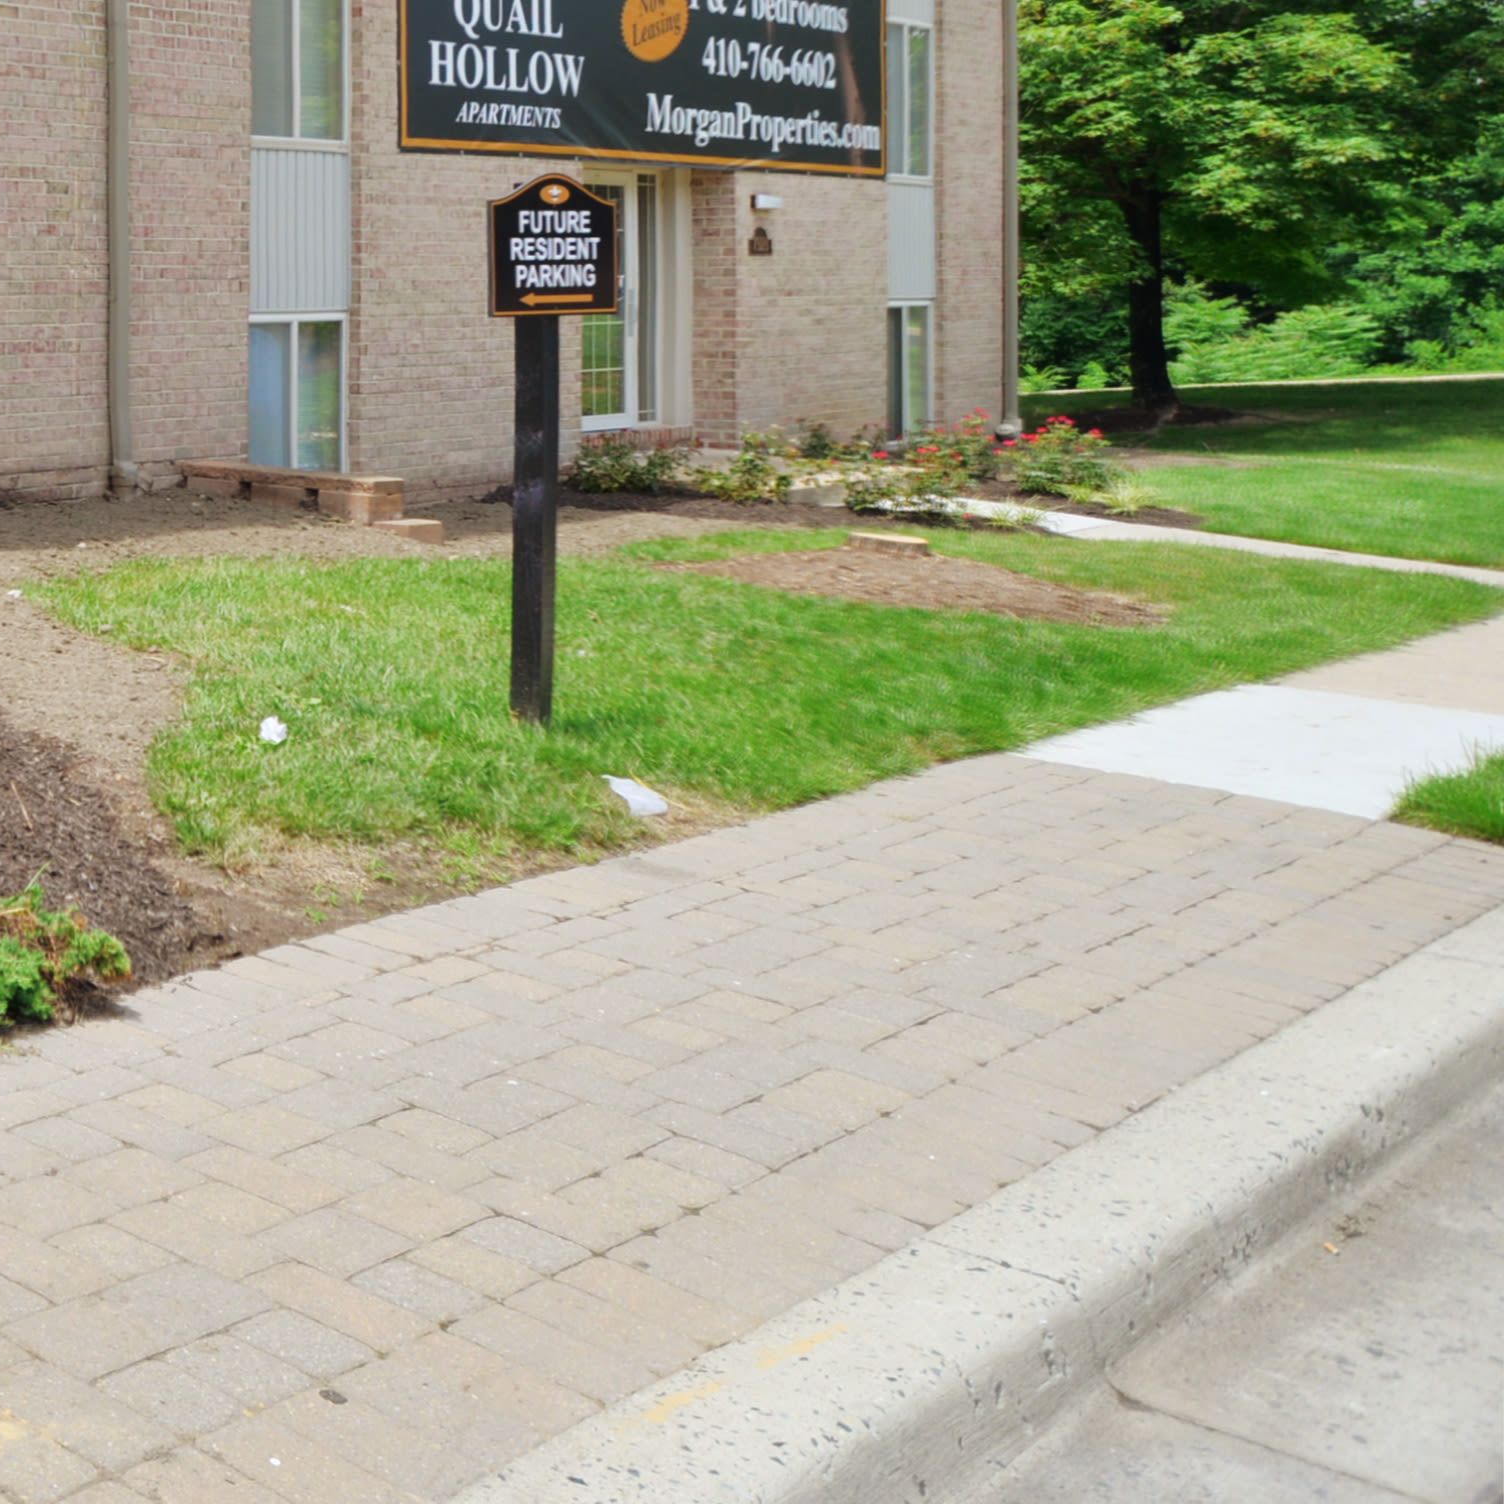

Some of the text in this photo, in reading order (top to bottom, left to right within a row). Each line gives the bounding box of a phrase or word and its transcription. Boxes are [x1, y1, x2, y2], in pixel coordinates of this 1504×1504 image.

[632, 11, 683, 46] Leasing
[428, 39, 585, 98] HOLLOW
[701, 35, 837, 89] 410-766-6602
[455, 101, 562, 129] APARTMENTS
[644, 92, 881, 152] MorganProperties.com
[518, 210, 592, 234] FUTURE
[510, 237, 601, 261] RESIDENT
[515, 264, 597, 288] PARKING
